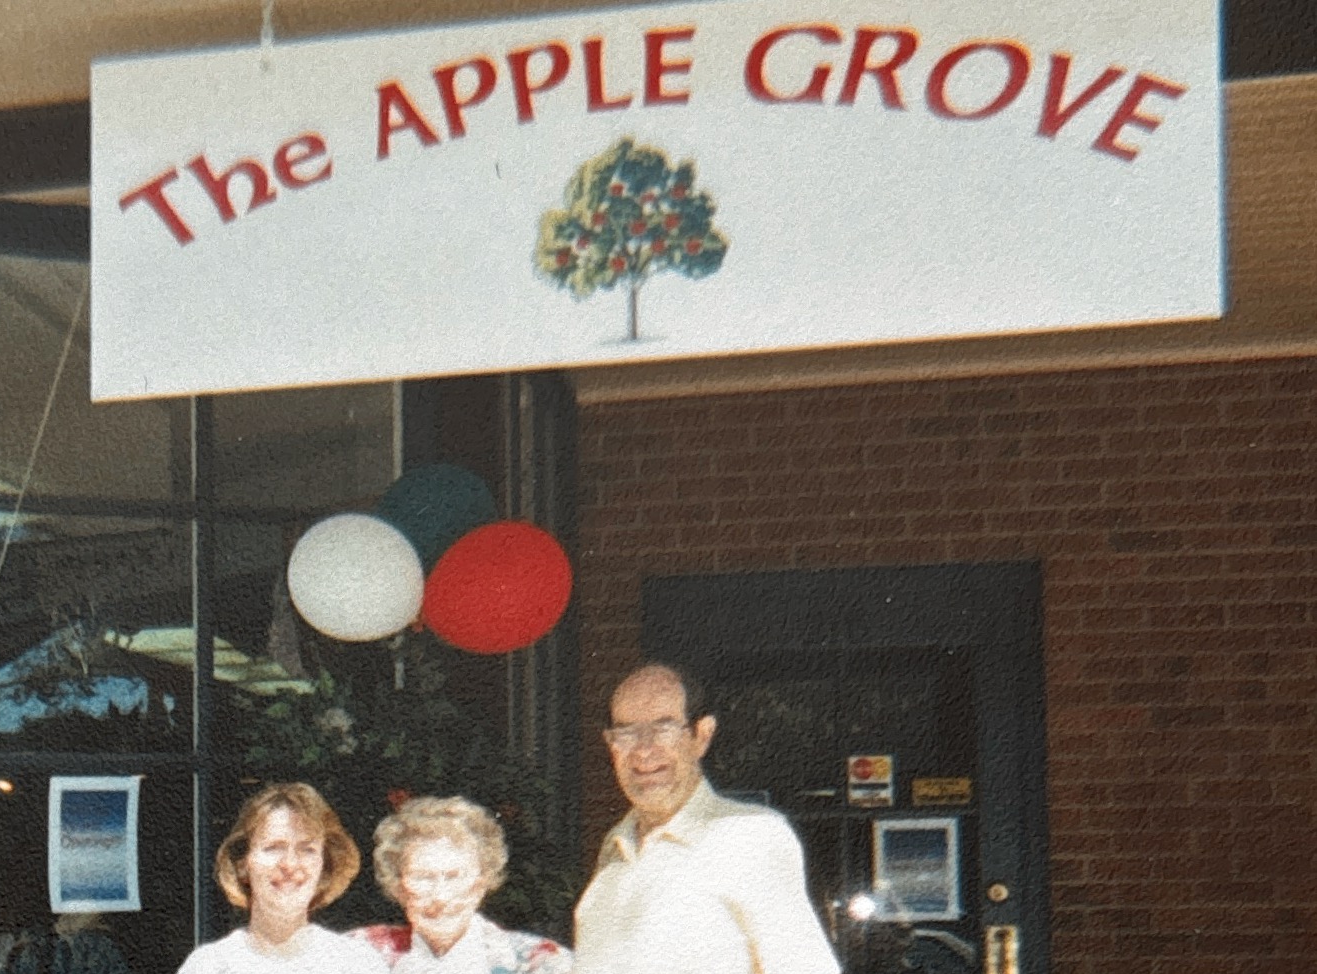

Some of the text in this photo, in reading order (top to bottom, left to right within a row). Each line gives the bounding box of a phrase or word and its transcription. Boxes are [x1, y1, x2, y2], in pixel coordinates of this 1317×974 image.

[118, 22, 1187, 247] The APPLE GROVE
